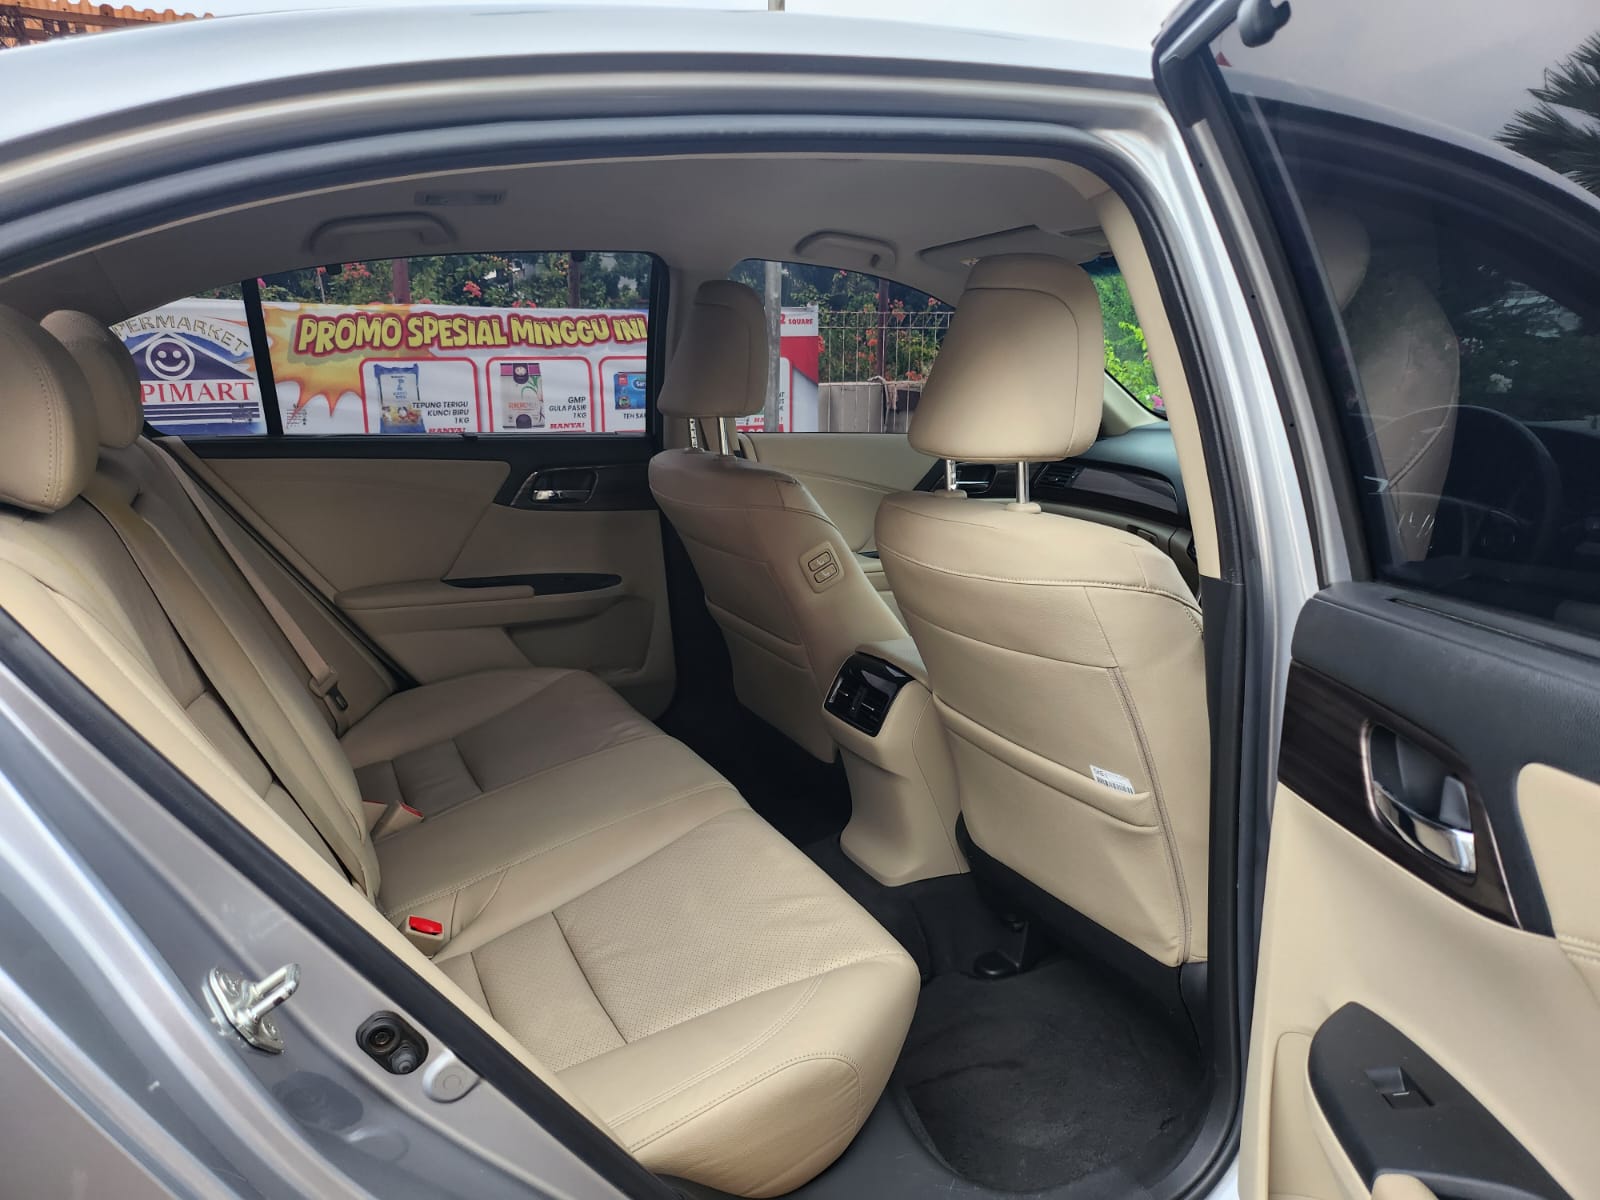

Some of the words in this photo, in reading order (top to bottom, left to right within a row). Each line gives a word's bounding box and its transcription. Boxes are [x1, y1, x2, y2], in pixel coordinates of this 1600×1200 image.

[298, 316, 402, 354] PROMO
[407, 315, 508, 348] SPESIAL
[510, 316, 610, 346] MINGGU
[613, 316, 647, 342] INI
[567, 396, 586, 404] GMP
[412, 401, 442, 409] TEPUNG
